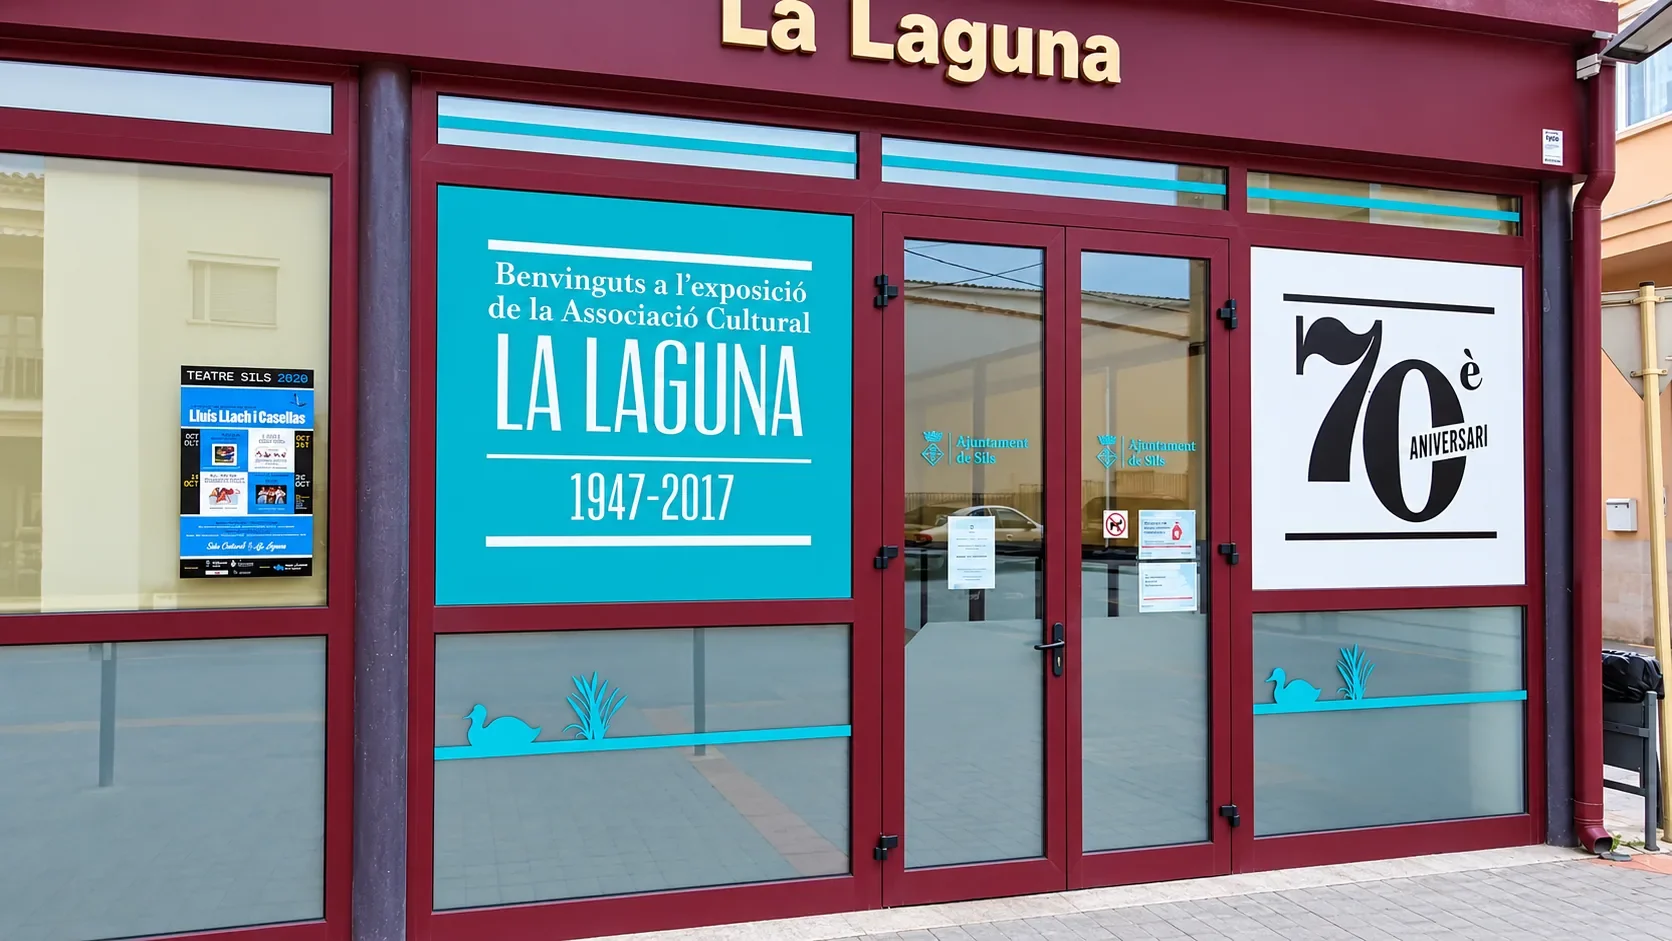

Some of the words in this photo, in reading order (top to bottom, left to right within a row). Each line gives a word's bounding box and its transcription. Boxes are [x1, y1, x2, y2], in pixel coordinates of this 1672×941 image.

[721, 0, 817, 54] La
[850, 0, 1121, 84] Laguna
[494, 261, 646, 297] Benvinguts
[653, 279, 668, 296] a
[675, 273, 807, 305] l'exposició
[488, 295, 521, 320] de
[529, 297, 554, 322] la
[561, 299, 699, 329] Associació
[705, 306, 811, 334] Cultural
[186, 370, 235, 382] TEATRE
[240, 372, 272, 382] SILS
[277, 373, 309, 383] 2020
[497, 333, 562, 431] LA
[586, 337, 803, 436] LAGUNA
[189, 409, 218, 423] Lluís
[219, 410, 250, 424] Llach
[252, 410, 257, 424] i
[258, 411, 306, 425] Casellas
[956, 435, 1029, 449] Ajuntament
[1128, 439, 1196, 453] Ajuntament
[1410, 424, 1488, 460] ANIVERSARI
[956, 451, 972, 464] de
[974, 451, 996, 464] Sils
[1127, 454, 1142, 467] de
[1144, 454, 1166, 467] Sils
[570, 472, 735, 521] 1947-2017
